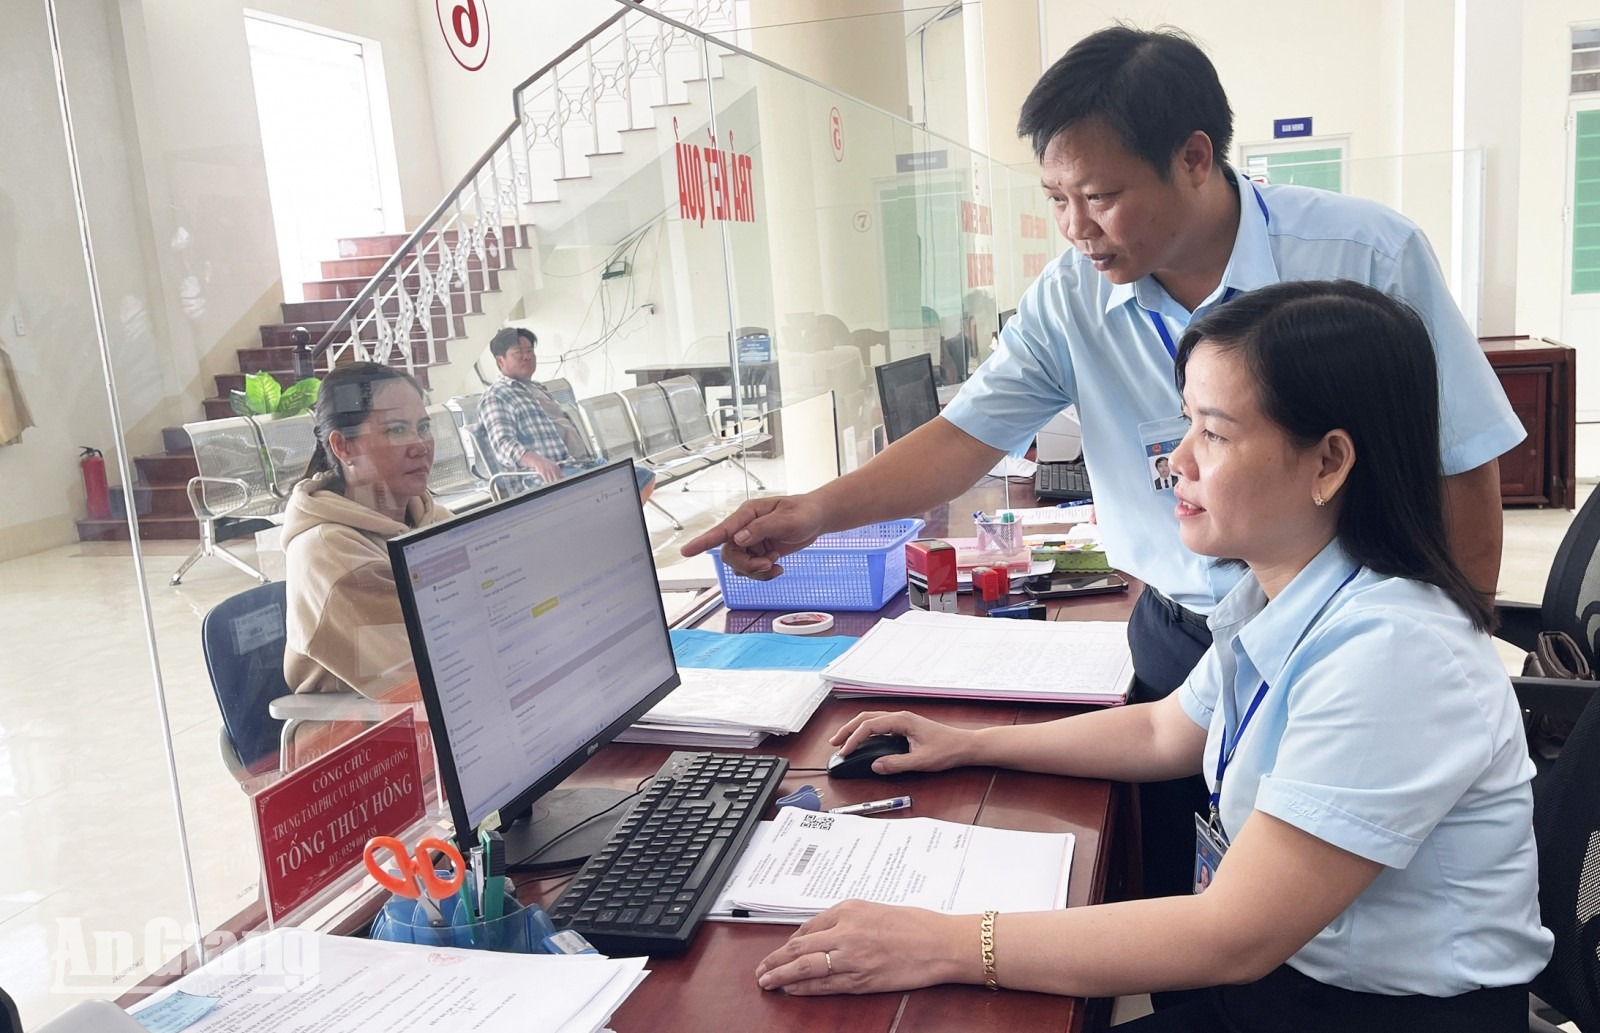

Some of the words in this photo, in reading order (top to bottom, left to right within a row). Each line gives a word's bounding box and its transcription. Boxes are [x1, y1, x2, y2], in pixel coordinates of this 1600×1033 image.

[857, 214, 868, 229] 7
[312, 765, 343, 793] CÔNG
[344, 747, 372, 775] CHỨC
[272, 813, 301, 841] TRUNG
[276, 830, 326, 879] TỐNG
[326, 799, 369, 844] THÚY
[371, 773, 413, 816] HỒNG
